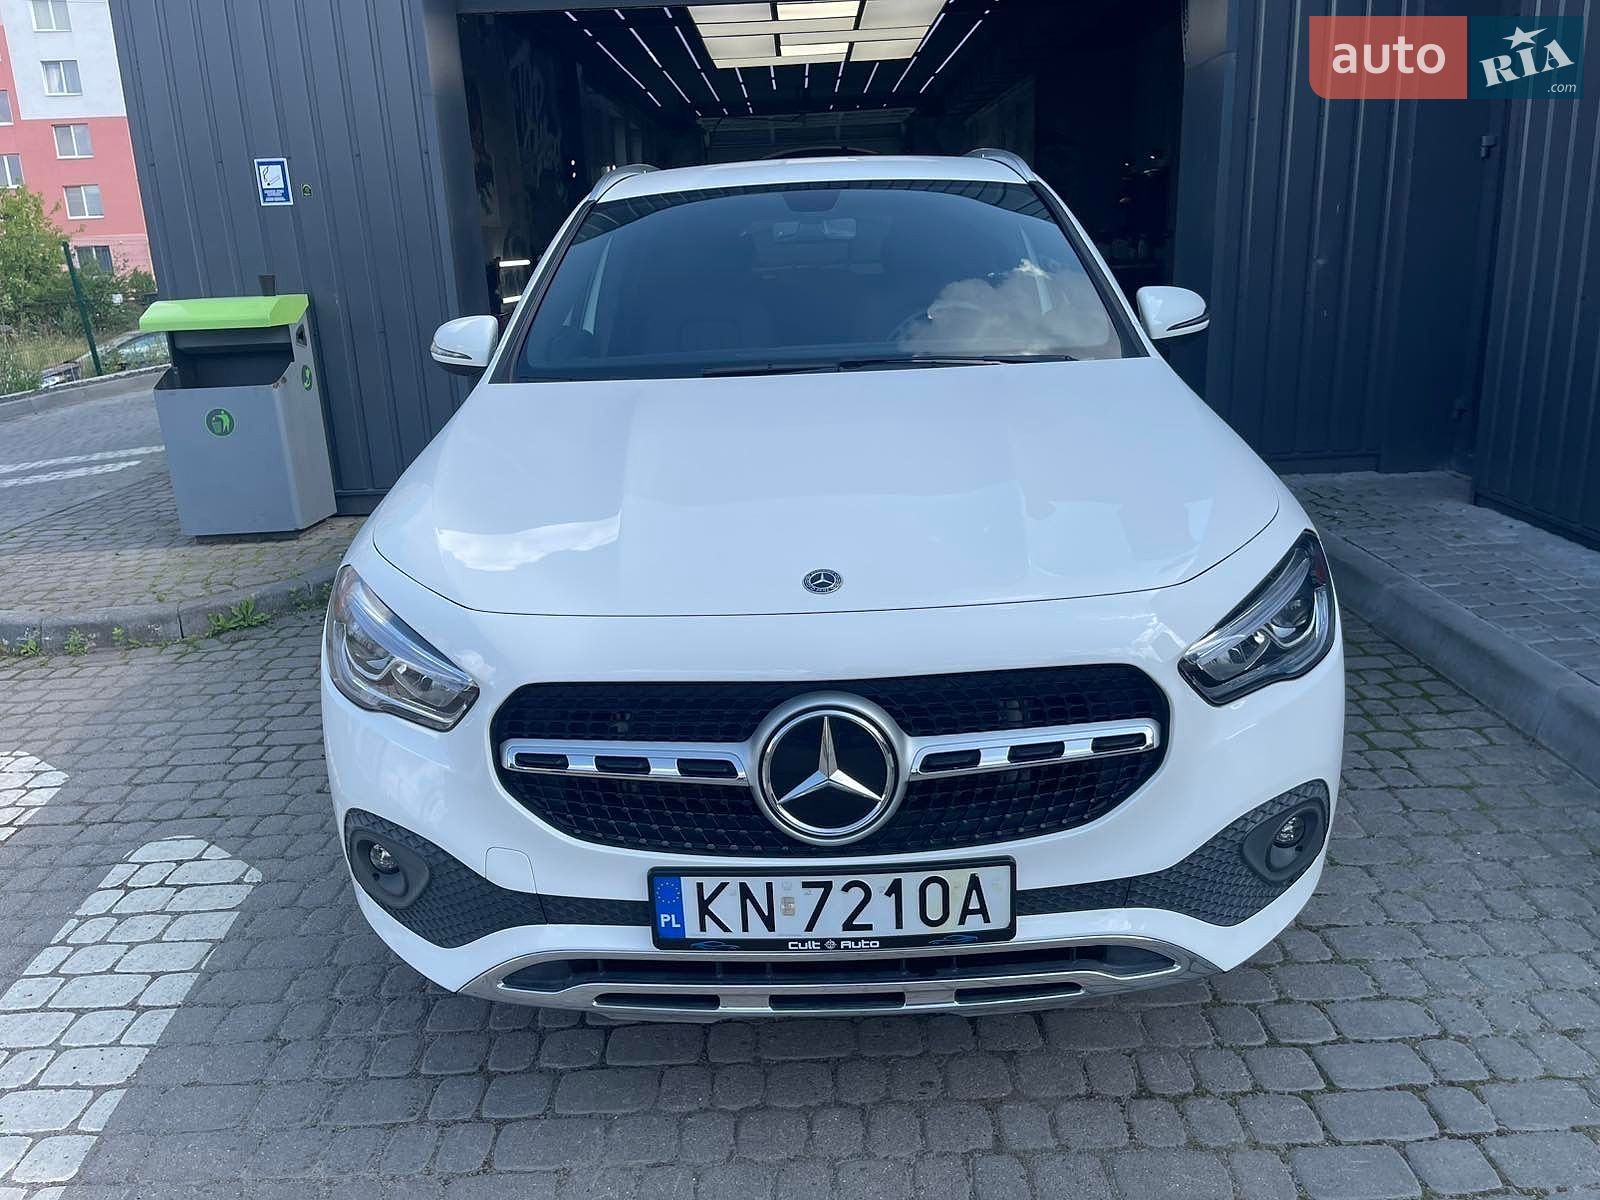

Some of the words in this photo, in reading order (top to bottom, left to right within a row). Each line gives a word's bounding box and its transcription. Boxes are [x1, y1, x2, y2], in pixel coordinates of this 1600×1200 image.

[695, 881, 775, 933] KN
[801, 872, 991, 932] 7210A
[660, 914, 681, 928] PL
[788, 940, 821, 950] Cult
[840, 939, 880, 949] Auto
